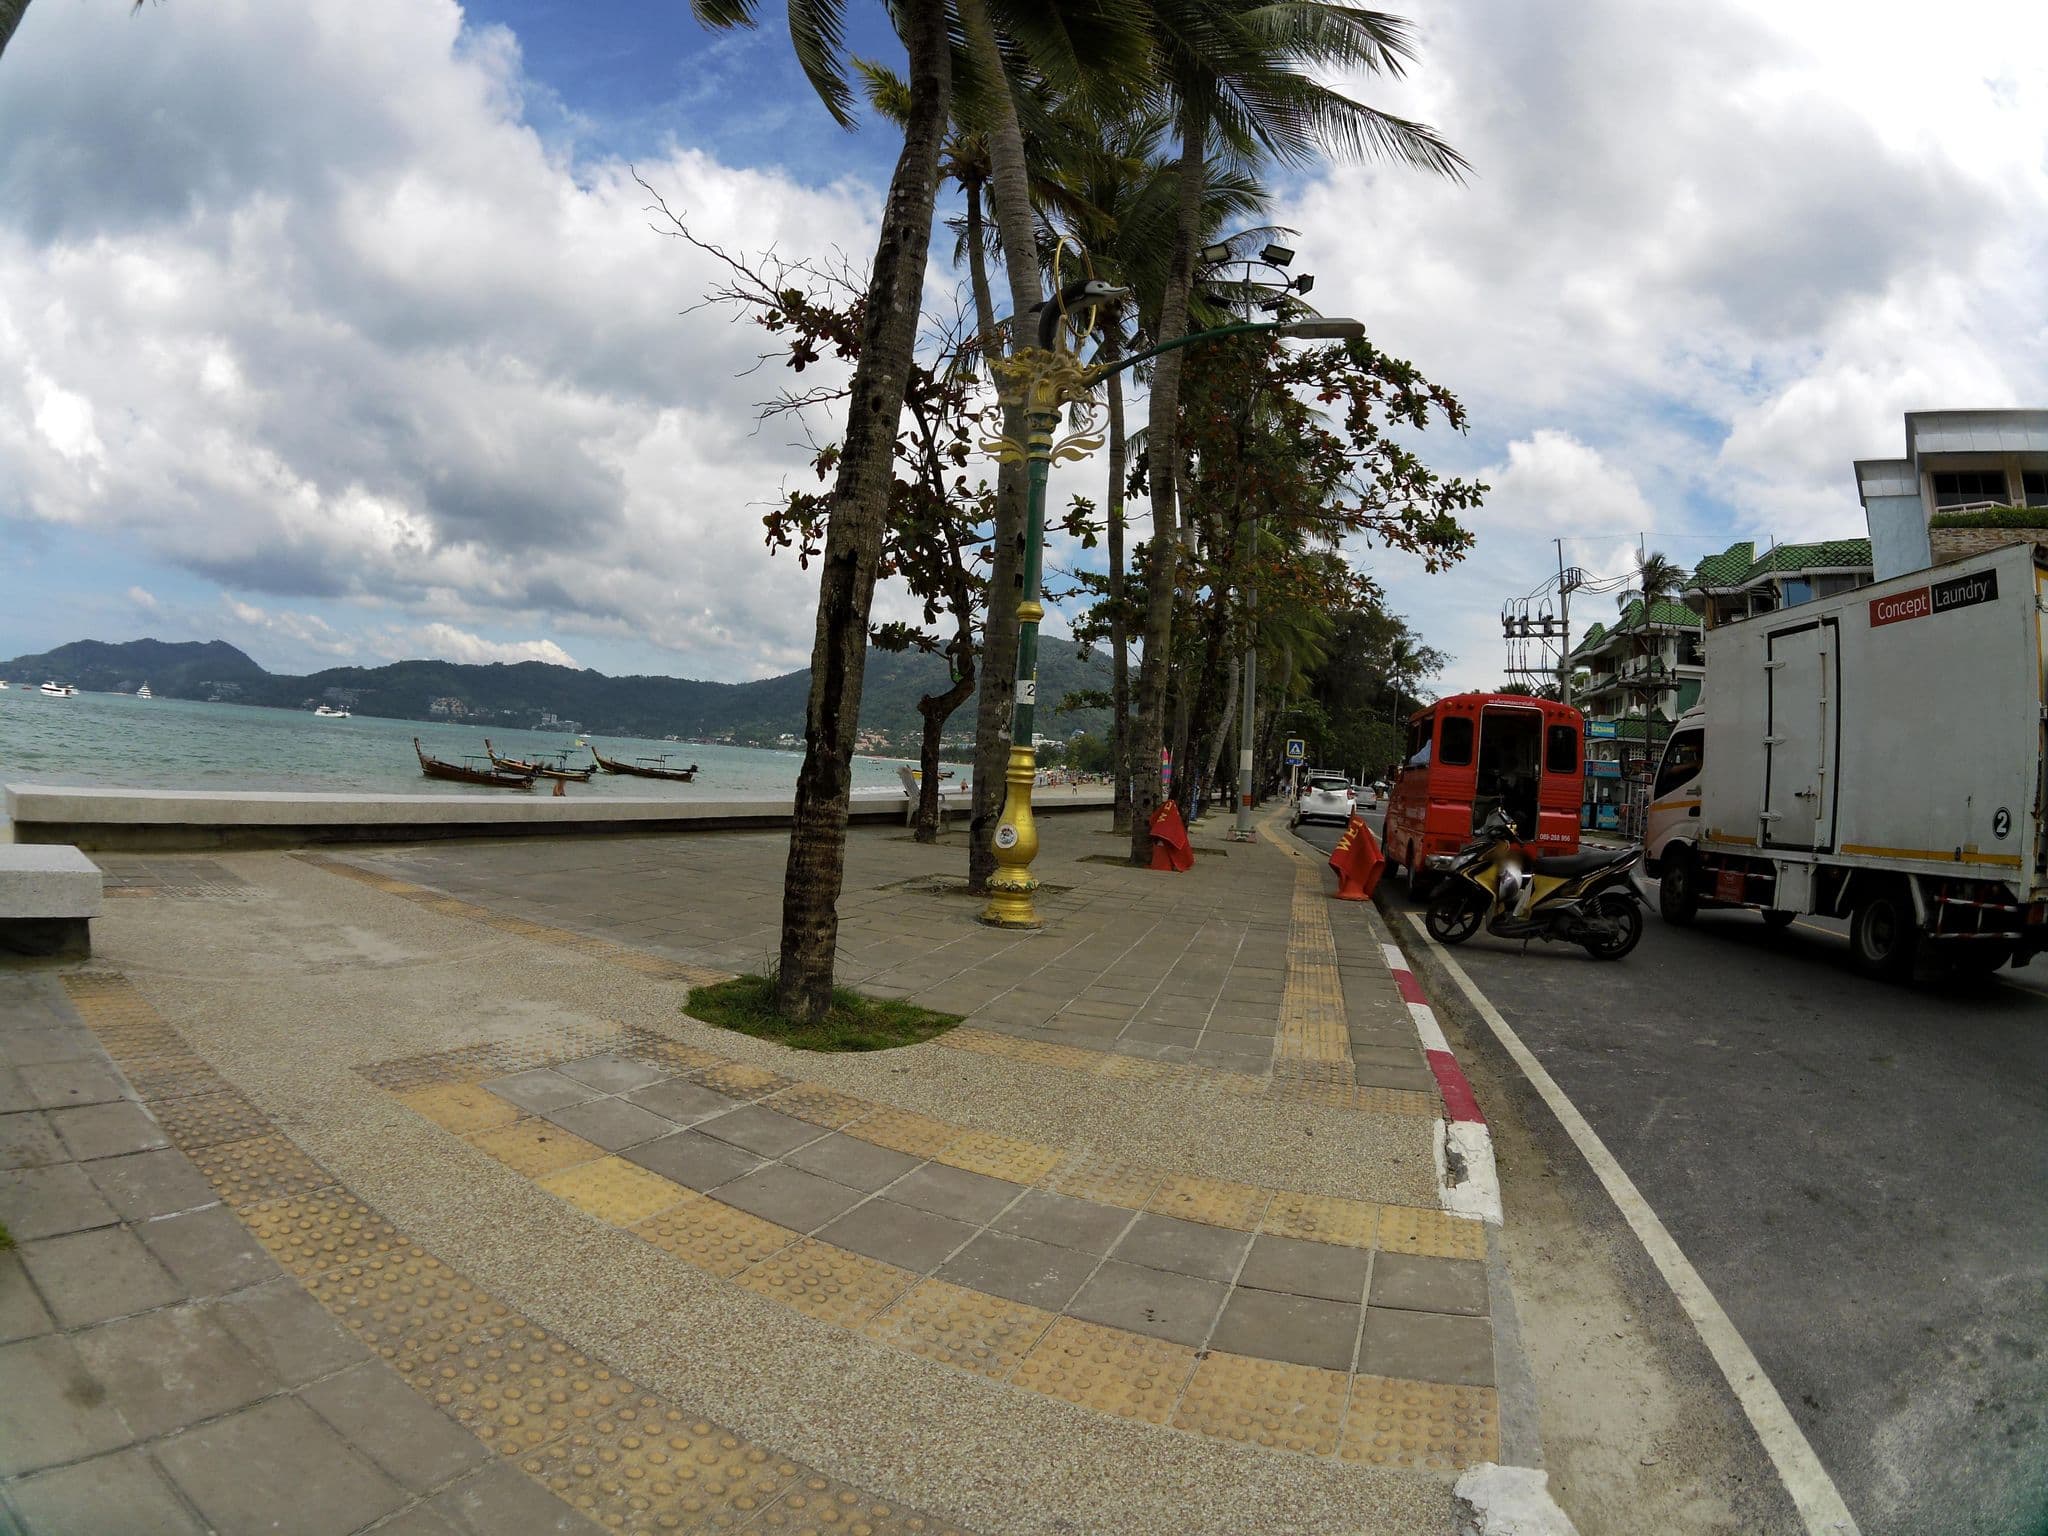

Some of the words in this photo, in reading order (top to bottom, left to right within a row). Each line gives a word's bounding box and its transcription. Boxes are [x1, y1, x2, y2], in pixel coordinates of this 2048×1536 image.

[1877, 594, 1928, 620] Concept
[1935, 579, 1988, 607] Laundry
[1027, 683, 1035, 697] 2
[1996, 811, 2008, 833] 2
